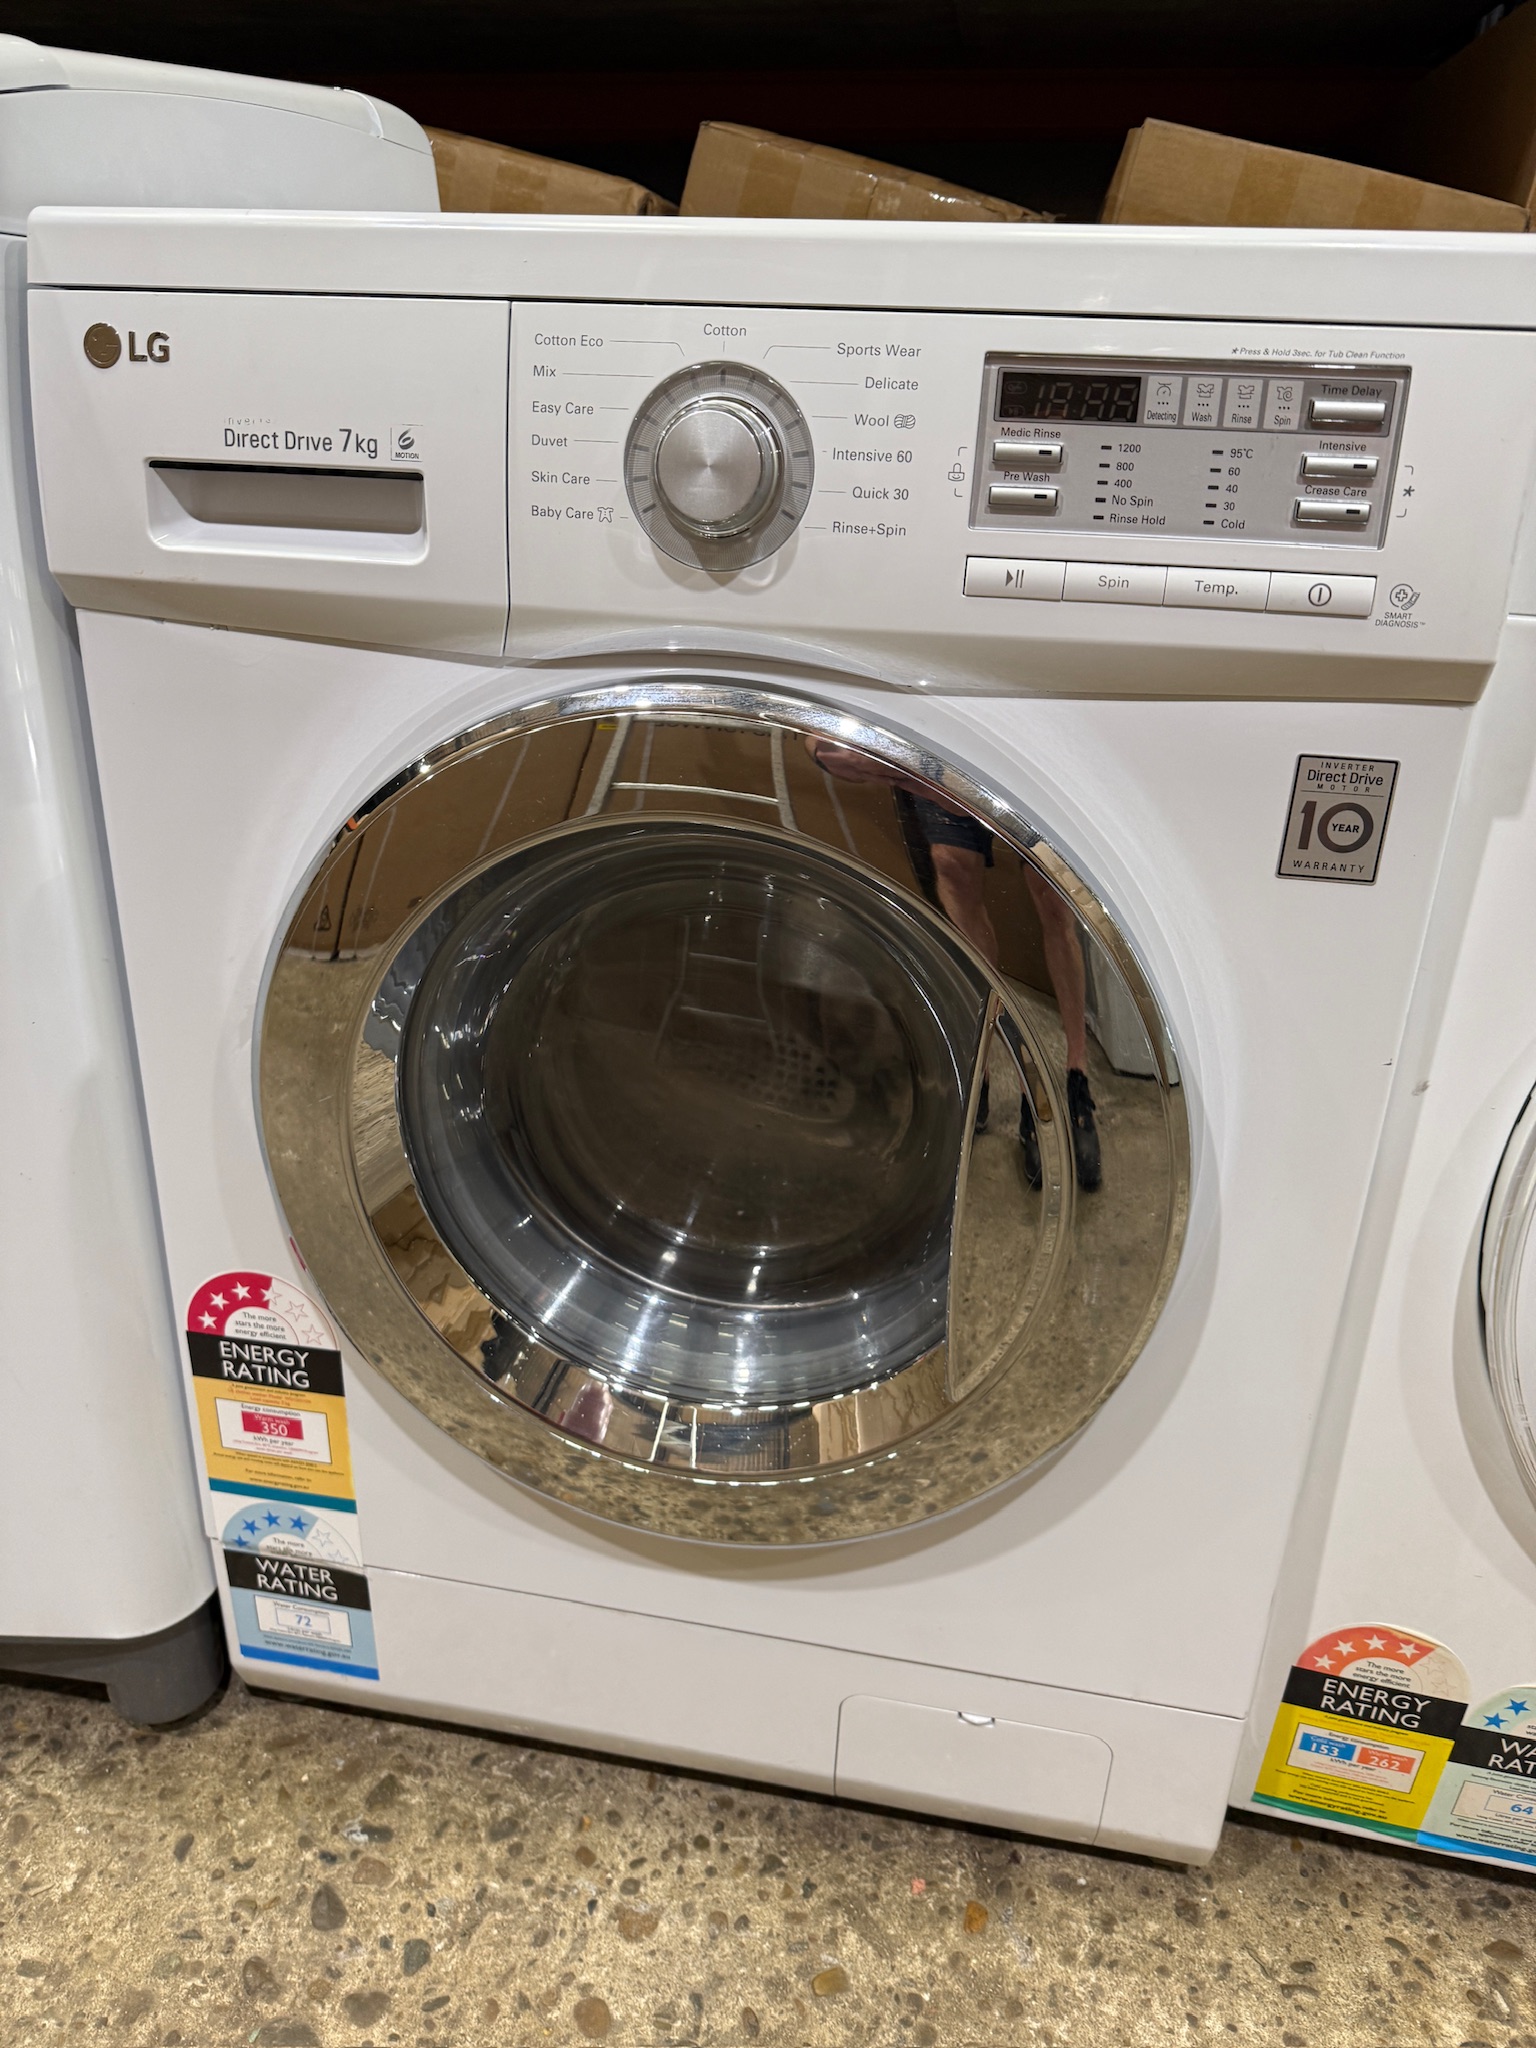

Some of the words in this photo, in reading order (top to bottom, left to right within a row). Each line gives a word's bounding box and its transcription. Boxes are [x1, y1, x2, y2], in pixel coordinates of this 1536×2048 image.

[703, 322, 748, 337] Cotton
[129, 331, 170, 362] LG
[534, 333, 577, 346] Cotton
[579, 335, 604, 348] Eco
[836, 342, 882, 358] Sports
[884, 344, 922, 358] Wear
[1264, 348, 1270, 356] &
[1314, 350, 1326, 358] for
[1370, 352, 1406, 360] Function
[532, 365, 557, 378] Mix
[864, 377, 919, 391] Delicate
[1321, 384, 1348, 394] Time
[1352, 386, 1382, 398] Delay
[532, 402, 562, 416] Easy
[565, 402, 594, 415] Care
[854, 414, 890, 427] Wool
[1146, 410, 1177, 422] Detecting
[1192, 412, 1212, 422] Wash
[1232, 414, 1252, 424] Rinse
[1274, 416, 1291, 426] Spin
[1001, 427, 1031, 438] Medic
[1034, 428, 1062, 438] Rinse
[224, 428, 279, 449] Direct
[285, 430, 333, 451] Drive
[531, 434, 568, 448] Duvet
[1318, 440, 1366, 452] Intensive
[1118, 443, 1142, 454] 1200
[395, 452, 420, 460] MOTION
[832, 448, 893, 462] Intensive
[896, 450, 912, 464] 60
[1116, 461, 1134, 472] 800
[1228, 466, 1240, 477] 60
[531, 471, 558, 484] Skin
[561, 472, 590, 485] Care
[1002, 471, 1022, 482] Pre
[1023, 472, 1050, 484] Wash
[1114, 478, 1132, 489] 400
[852, 486, 891, 500] Quick
[894, 488, 909, 501] 30
[1225, 483, 1238, 494] 40
[1304, 485, 1341, 497] Crease
[1344, 486, 1367, 498] Care
[1112, 495, 1128, 506] No
[1130, 496, 1154, 509] Spin
[1223, 500, 1236, 512] 30
[531, 506, 562, 520] Baby
[565, 507, 594, 520] Care
[1109, 514, 1138, 526] Rinse
[1140, 514, 1166, 526] Hold
[1220, 518, 1245, 531] Cold
[832, 522, 908, 537] Rinse+Spin
[1098, 575, 1130, 591] Spin
[1194, 580, 1239, 598] Temp.
[1384, 612, 1413, 620] SMART
[1320, 761, 1374, 772] INVERTER
[1308, 770, 1347, 783] Direct
[1350, 772, 1384, 786] Drive
[1317, 783, 1370, 792] MOTOR
[1298, 800, 1374, 854] 10
[1332, 823, 1360, 833] YEAR
[1293, 860, 1364, 873] WARRANTY
[242, 1311, 256, 1320] The
[258, 1314, 276, 1322] more
[235, 1328, 258, 1338] energy
[254, 1322, 264, 1330] the
[266, 1324, 285, 1332] more
[219, 1341, 310, 1368] ENERGY
[222, 1360, 310, 1388] RATING
[241, 1403, 261, 1412] Energy
[261, 1422, 288, 1436] 350
[256, 1557, 334, 1584] WATER
[257, 1573, 338, 1600] RATING
[295, 1614, 312, 1627] 72
[1367, 1660, 1382, 1669] The
[1383, 1666, 1404, 1674] more
[1352, 1672, 1378, 1682] energy
[1380, 1678, 1410, 1688] efficient
[1356, 1666, 1374, 1674] stars
[1376, 1670, 1388, 1678] the
[1390, 1674, 1412, 1682] more
[1323, 1678, 1430, 1713] ENERGY
[1320, 1696, 1422, 1729] RATING
[1328, 1732, 1350, 1741] Energy
[1310, 1742, 1340, 1757] 153
[1370, 1756, 1400, 1770] 262
[1493, 1789, 1514, 1798] Water
[1510, 1804, 1534, 1815] 64
